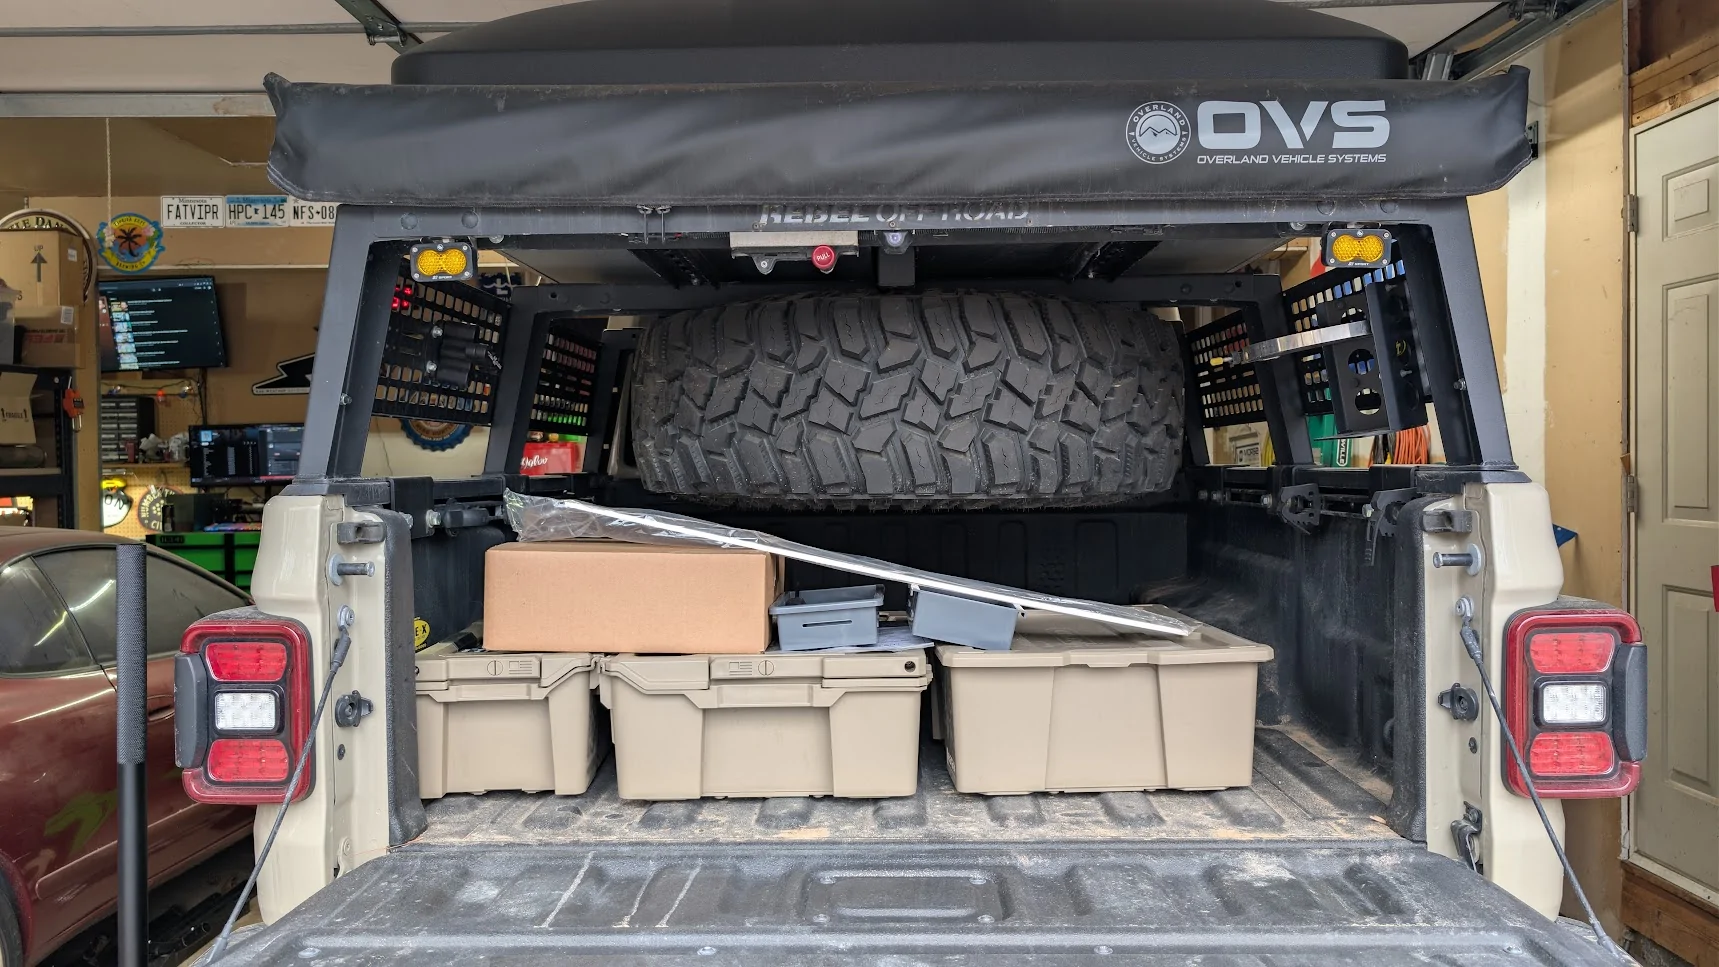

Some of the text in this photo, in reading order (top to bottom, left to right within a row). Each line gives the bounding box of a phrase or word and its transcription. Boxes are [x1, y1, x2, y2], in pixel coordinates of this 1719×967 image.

[1133, 104, 1186, 126] OVERLAND
[1197, 100, 1390, 149] OVS
[1132, 137, 1187, 161] VEHICLE SYSTEMS
[1197, 153, 1387, 164] OVERLAND VEHICLE SYSTEMS
[167, 204, 219, 220] FATVIPR
[228, 204, 285, 220] HPC 145
[293, 205, 314, 220] NFS
[816, 251, 831, 261] PULL
